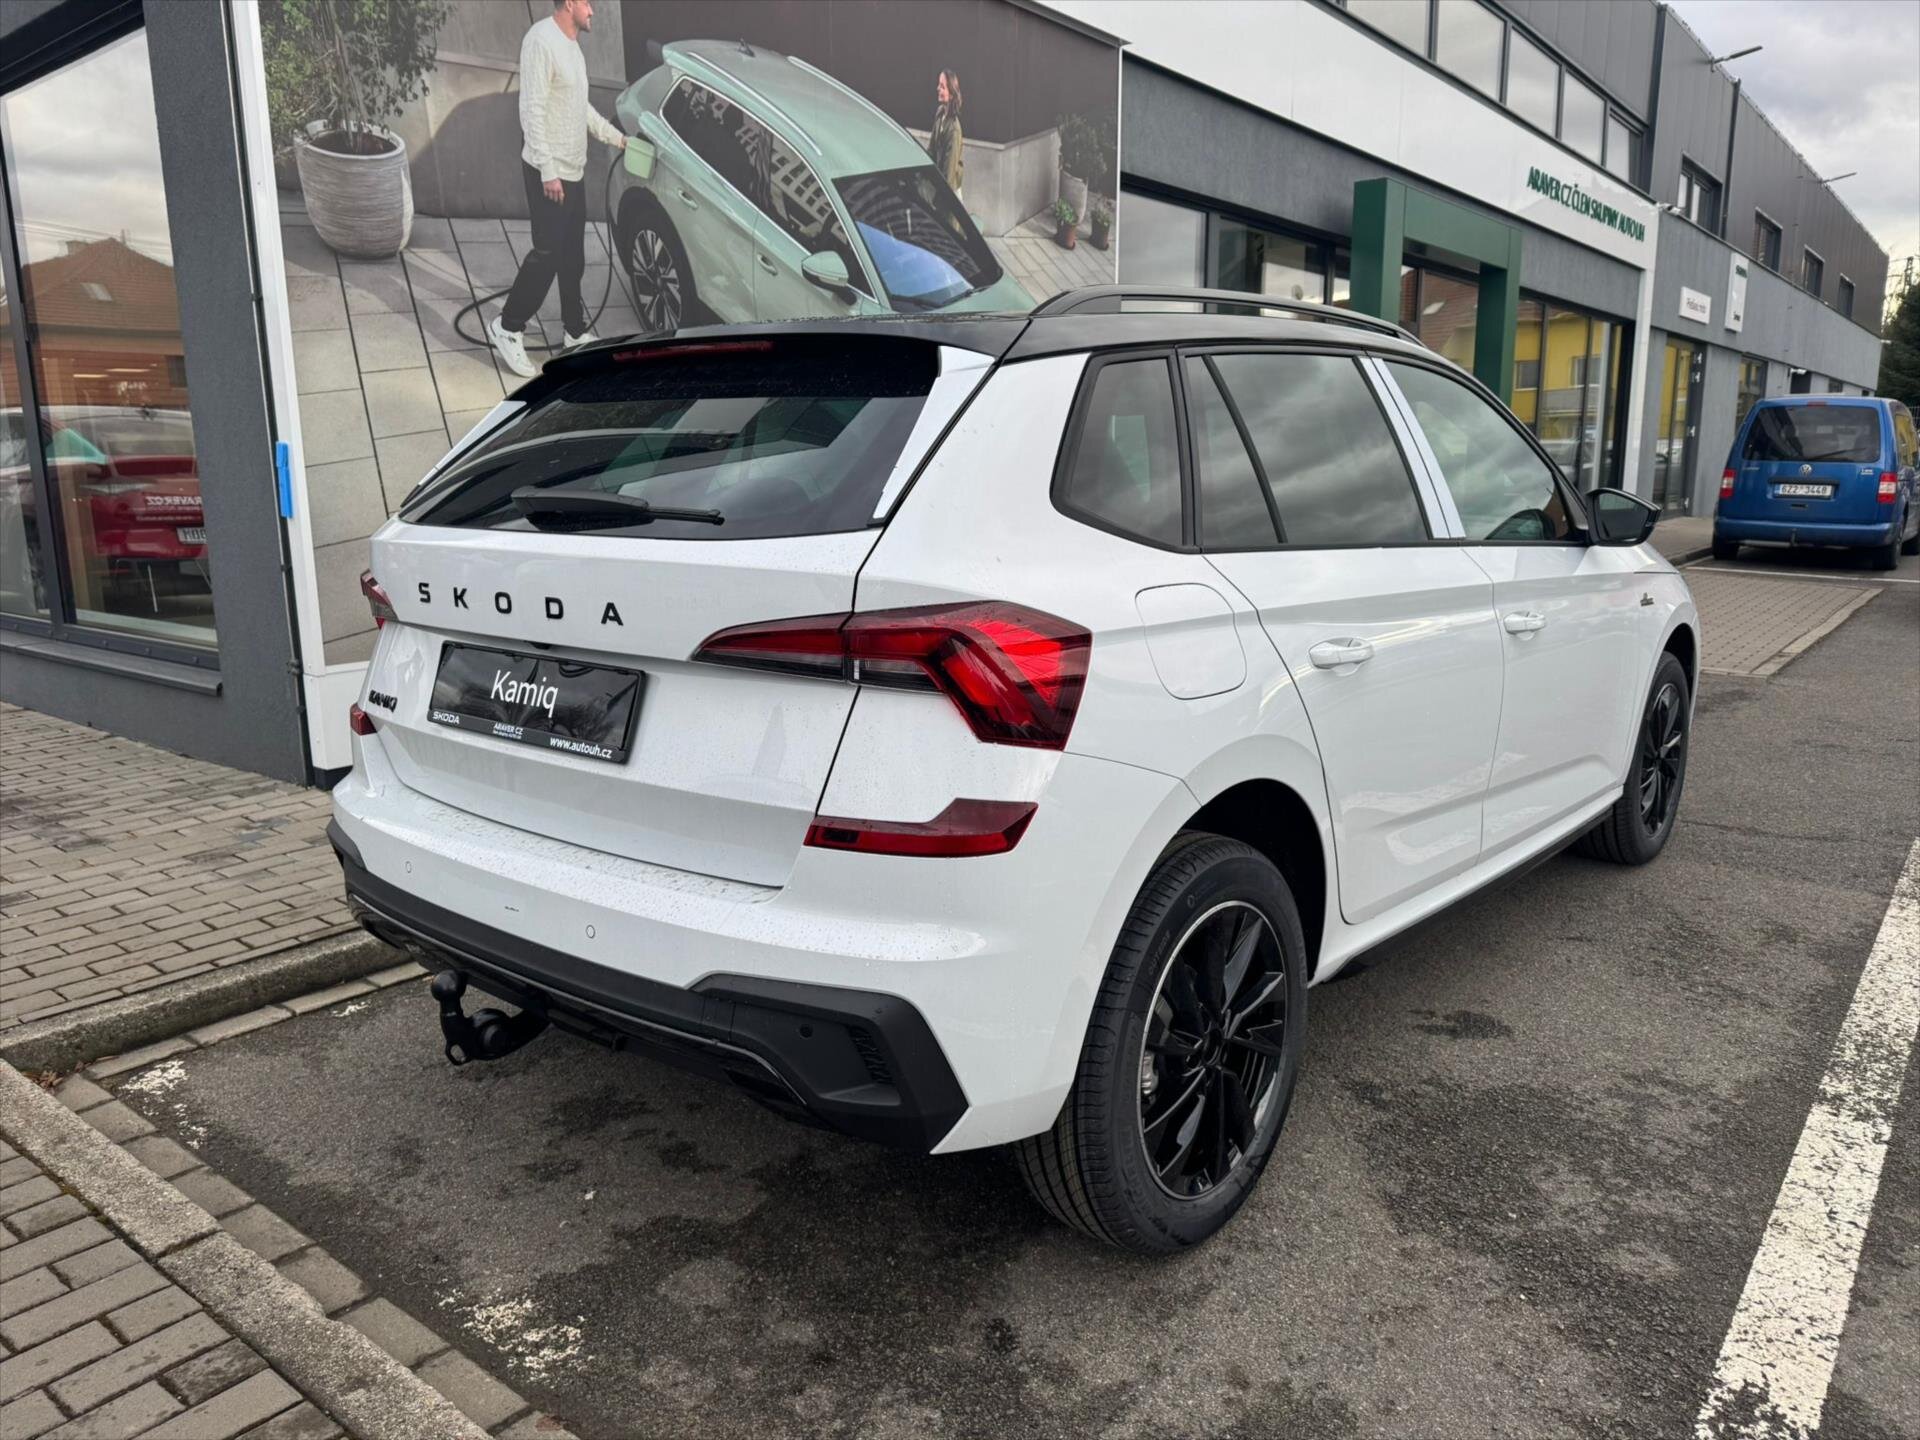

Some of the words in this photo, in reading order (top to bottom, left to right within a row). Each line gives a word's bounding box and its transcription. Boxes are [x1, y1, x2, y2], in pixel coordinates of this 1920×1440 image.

[1527, 166, 1561, 202] ARAVER
[1561, 184, 1573, 208] CZ
[418, 582, 624, 626] SKODA
[490, 669, 559, 718] Kamiq
[550, 737, 612, 759] www.autouh.cz
